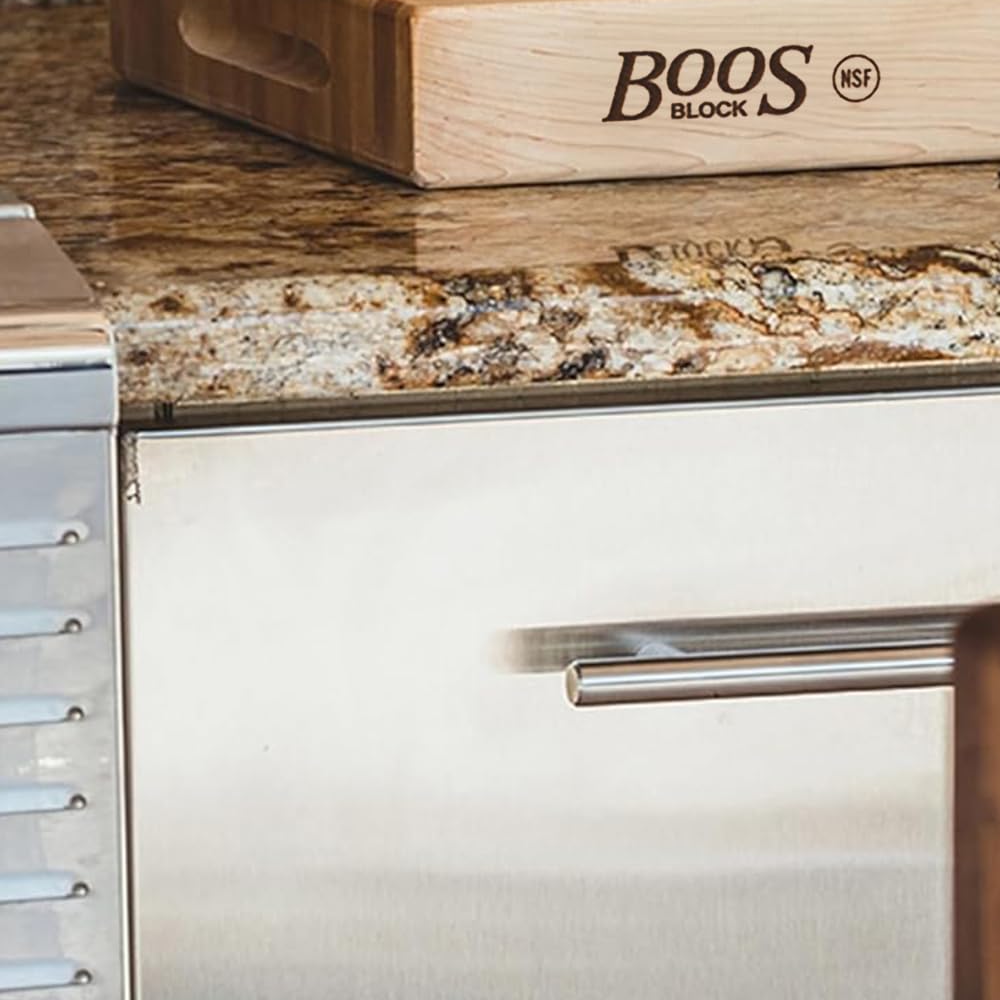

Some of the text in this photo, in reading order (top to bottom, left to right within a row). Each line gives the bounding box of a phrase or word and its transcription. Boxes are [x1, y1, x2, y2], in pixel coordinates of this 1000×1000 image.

[602, 45, 814, 122] BOOS
[840, 68, 872, 88] NSF
[671, 100, 748, 119] BLOCK
